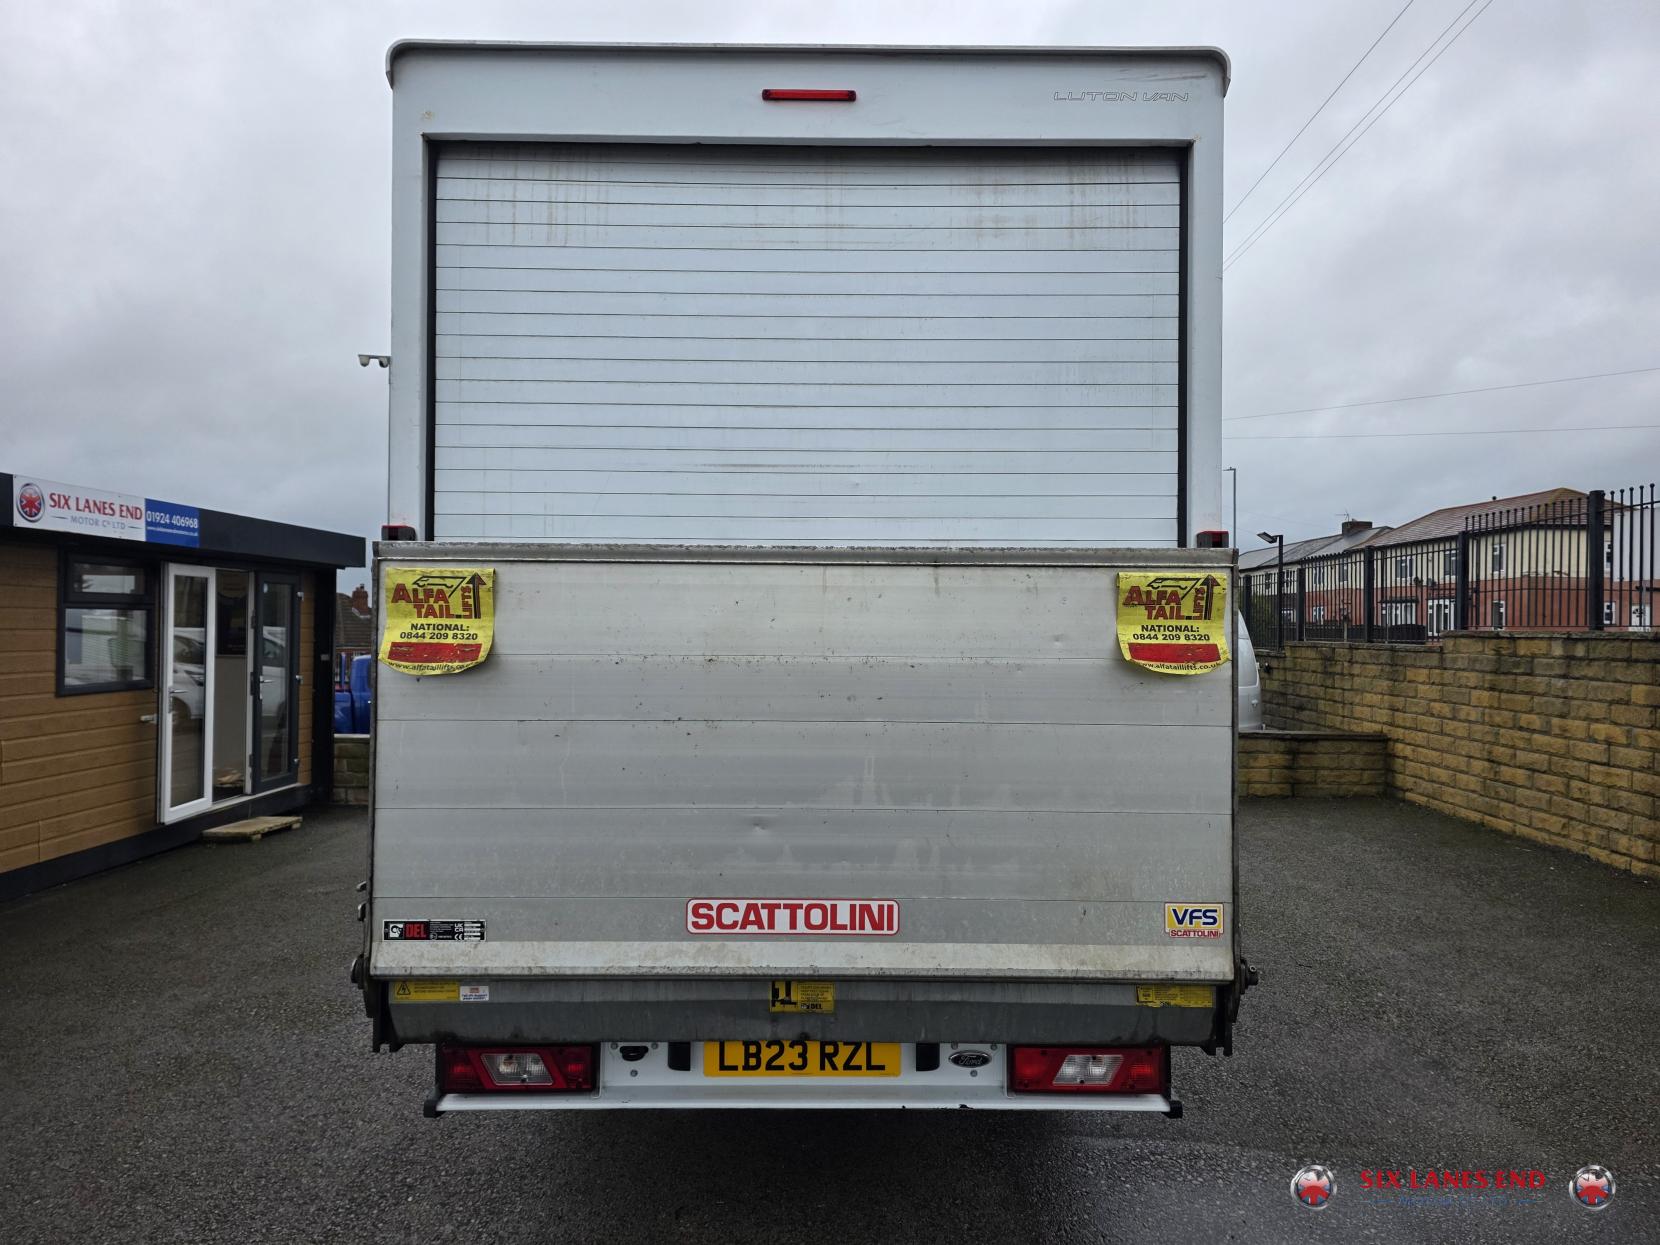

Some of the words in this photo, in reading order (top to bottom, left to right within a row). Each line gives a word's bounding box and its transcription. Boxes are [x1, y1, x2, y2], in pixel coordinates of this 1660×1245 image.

[1053, 91, 1137, 101] LUTON
[1143, 92, 1188, 102] VAN
[49, 493, 71, 510] SIX
[76, 497, 115, 517] LANES
[119, 504, 143, 521] END
[71, 515, 100, 527] MOTOR
[112, 522, 126, 531] LTD
[147, 511, 170, 524] 01924
[172, 515, 198, 529] 406968
[391, 583, 449, 604] ALFA
[1123, 586, 1181, 606] ALFA
[414, 604, 454, 618] TAIL
[1145, 606, 1185, 620] TAIL
[411, 624, 470, 632] NATIONAL:
[1141, 625, 1200, 633] NATIONAL:
[400, 632, 426, 640] 0844
[429, 632, 449, 640] 209
[452, 633, 478, 641] 8320
[691, 902, 894, 931] SCATTOLINI
[1172, 908, 1218, 926] VFS
[1170, 929, 1219, 938] SCATTOLINI
[719, 1040, 808, 1071] LB23
[819, 1040, 886, 1071] RZL
